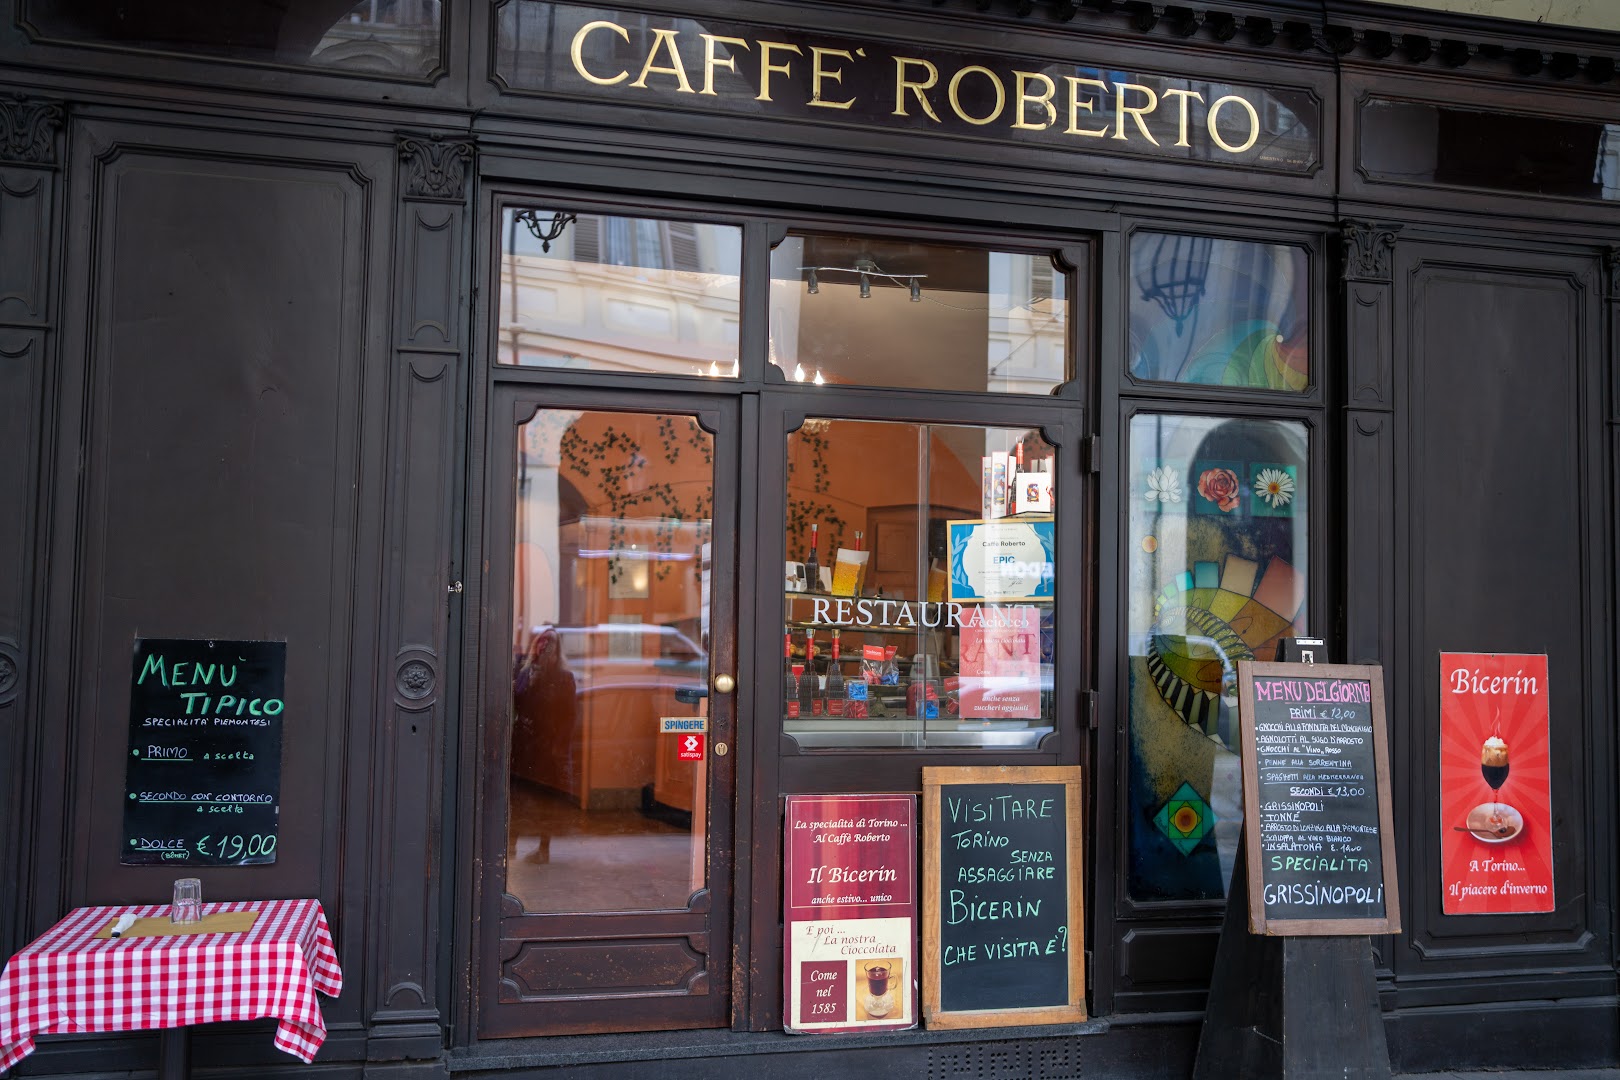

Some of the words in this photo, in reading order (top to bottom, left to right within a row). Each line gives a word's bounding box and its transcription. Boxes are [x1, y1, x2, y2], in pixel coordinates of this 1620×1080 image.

[890, 55, 1260, 154] ROBERTO
[993, 555, 1016, 564] EPIC
[811, 597, 1036, 629] RESTAURANT
[1450, 668, 1539, 695] Bicerin
[1254, 680, 1303, 702] MENU
[180, 692, 285, 716] TIPICO
[1001, 704, 1029, 712] aggiunti
[1289, 705, 1317, 719] PRIMI
[1319, 709, 1328, 718] €
[1331, 707, 1356, 720] 12,00
[213, 717, 271, 727] PIEMONTESI
[664, 720, 705, 730] SPINGERE
[1258, 721, 1284, 731] GNOCCHI
[1260, 733, 1298, 743] AGNOLOTTI
[1299, 735, 1310, 743] AL
[1311, 735, 1329, 744] SUGO
[147, 745, 188, 759] PRIMO
[215, 751, 254, 760] scelta
[1260, 743, 1290, 753] GNOCCHI
[1324, 746, 1342, 754] ROSSO
[1308, 759, 1353, 768] SORRENTINA
[139, 791, 187, 800] SECONDO
[191, 792, 213, 801] CON
[215, 793, 273, 803] CONTORNO
[1289, 786, 1324, 796] SECONDI
[1335, 786, 1366, 798] 13,00
[208, 804, 244, 813] scelta
[948, 795, 1055, 823] VISITARE
[1264, 800, 1324, 812] GRISSINOPOLI
[794, 820, 807, 829] La
[809, 819, 853, 831] specialità
[856, 818, 865, 828] di
[867, 817, 899, 828] Torino
[1265, 822, 1292, 831] ARROSTO
[141, 837, 185, 849] DOLCE
[813, 834, 828, 843] Al
[827, 832, 852, 846] Caffè
[853, 832, 891, 842] Roberto
[1307, 834, 1324, 842] VINO
[1325, 834, 1352, 843] BIANCO
[1266, 840, 1323, 852] INSALATONA
[1010, 850, 1053, 864] SENZA
[1469, 860, 1480, 872] A
[1481, 857, 1526, 872] Torino...
[806, 865, 828, 884] Il
[828, 864, 898, 884] Bicerin
[957, 865, 1056, 883] ASSAGGIARE
[1263, 879, 1384, 906] GRISSINOPOLI
[1448, 882, 1460, 896] Il
[1459, 882, 1498, 901] piacere
[1499, 882, 1548, 895] d'inverno
[811, 893, 835, 905] anche
[836, 893, 868, 903] estivo...
[870, 892, 893, 902] unico
[947, 889, 1042, 925] BICERIN
[805, 925, 815, 936] E
[815, 924, 834, 938] poi
[823, 935, 837, 946] La
[841, 935, 876, 944] nostra
[840, 942, 897, 955] Cioccolata
[944, 944, 977, 966] CHE
[984, 937, 1040, 960] VISITA
[810, 969, 838, 982] Come
[815, 984, 834, 997] nel
[811, 1003, 837, 1014] 1585
